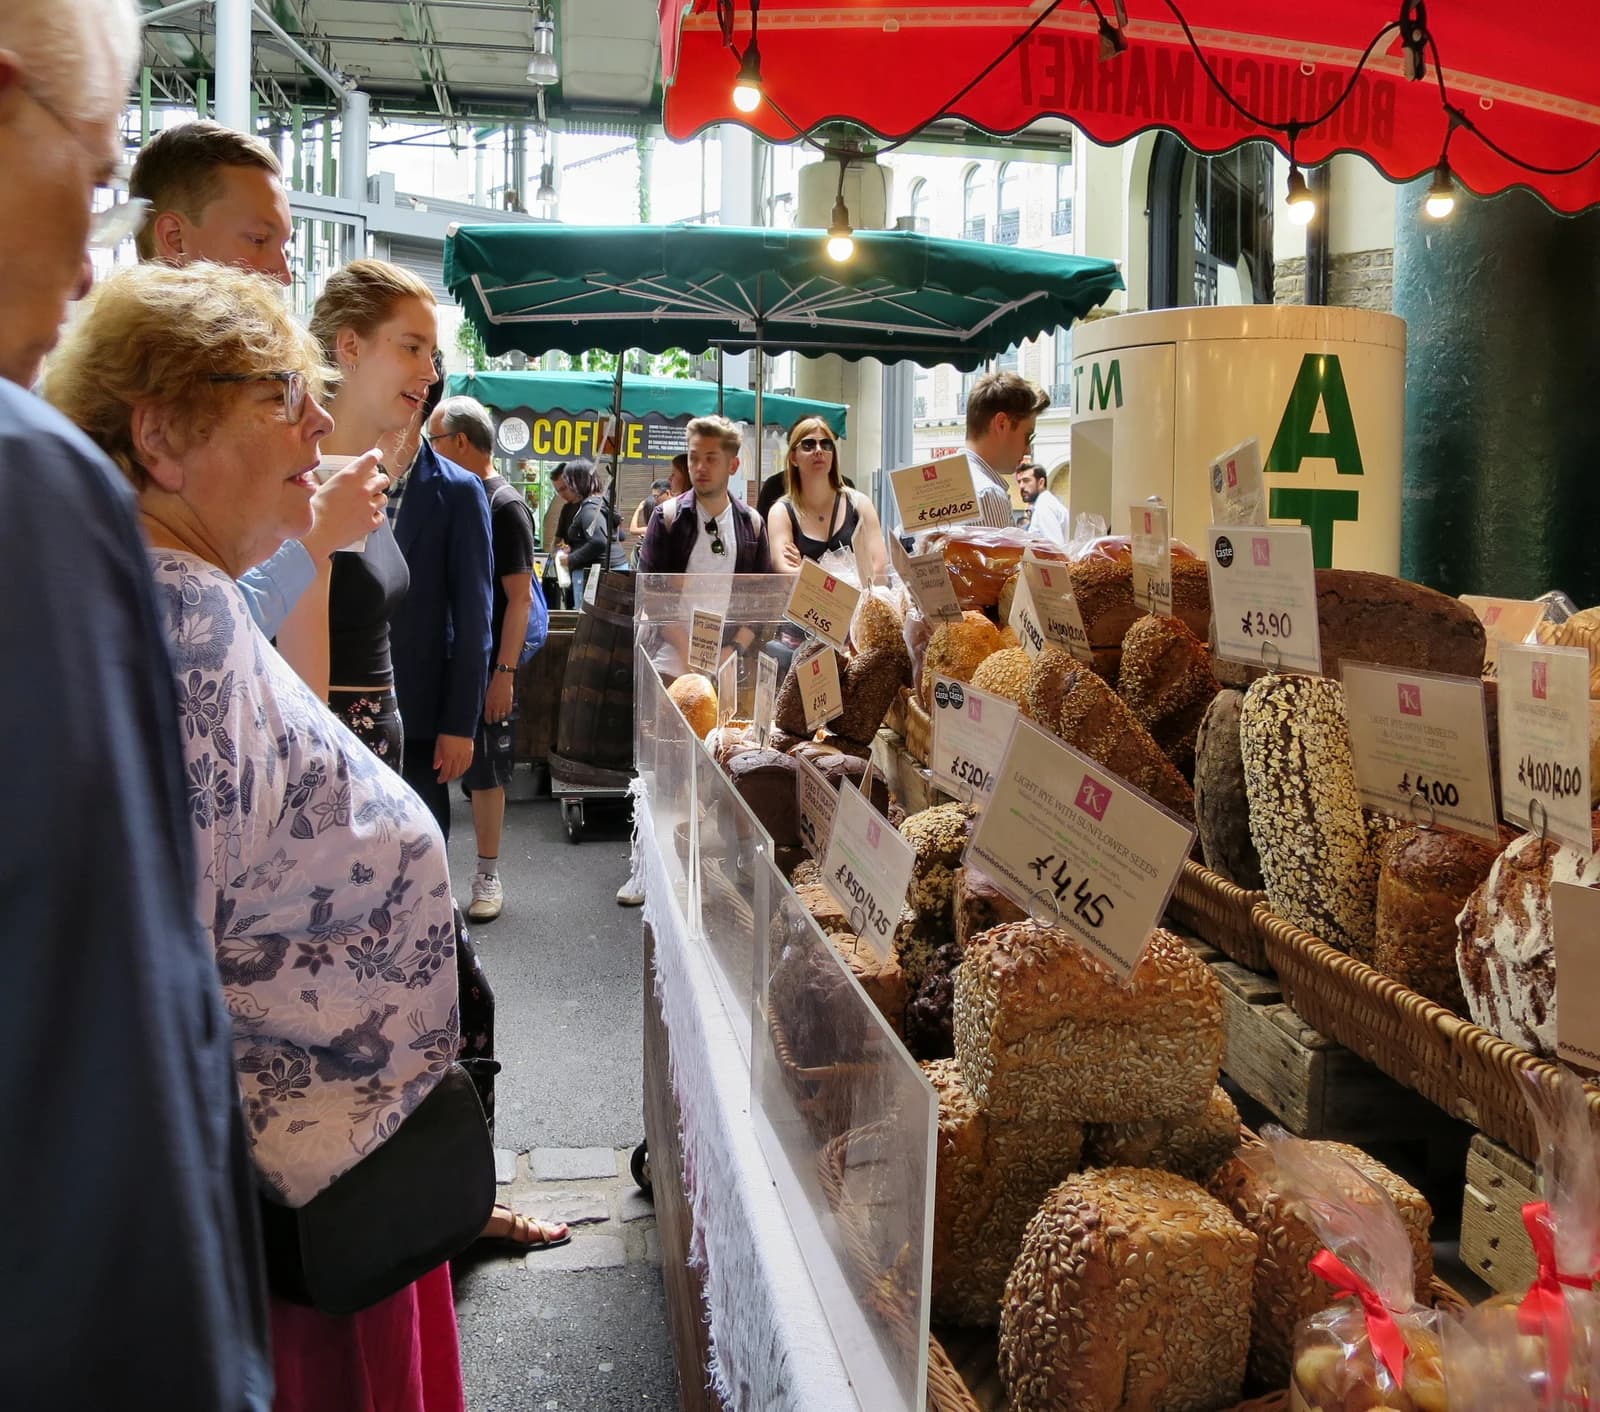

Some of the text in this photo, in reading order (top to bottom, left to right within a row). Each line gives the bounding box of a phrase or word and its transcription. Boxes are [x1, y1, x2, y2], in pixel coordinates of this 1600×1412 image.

[533, 418, 643, 459] COFE
[1216, 548, 1233, 558] taste
[803, 608, 832, 632] £4.55
[1241, 610, 1292, 639] £3.90
[1397, 772, 1460, 807] £4.00
[1014, 771, 1040, 794] LIGHT
[1039, 789, 1055, 806] RYE
[1055, 799, 1078, 822] WITH
[1076, 815, 1130, 858] SUNFLOWER
[1129, 852, 1159, 879] SEEDS
[1028, 854, 1115, 928] £4.45
